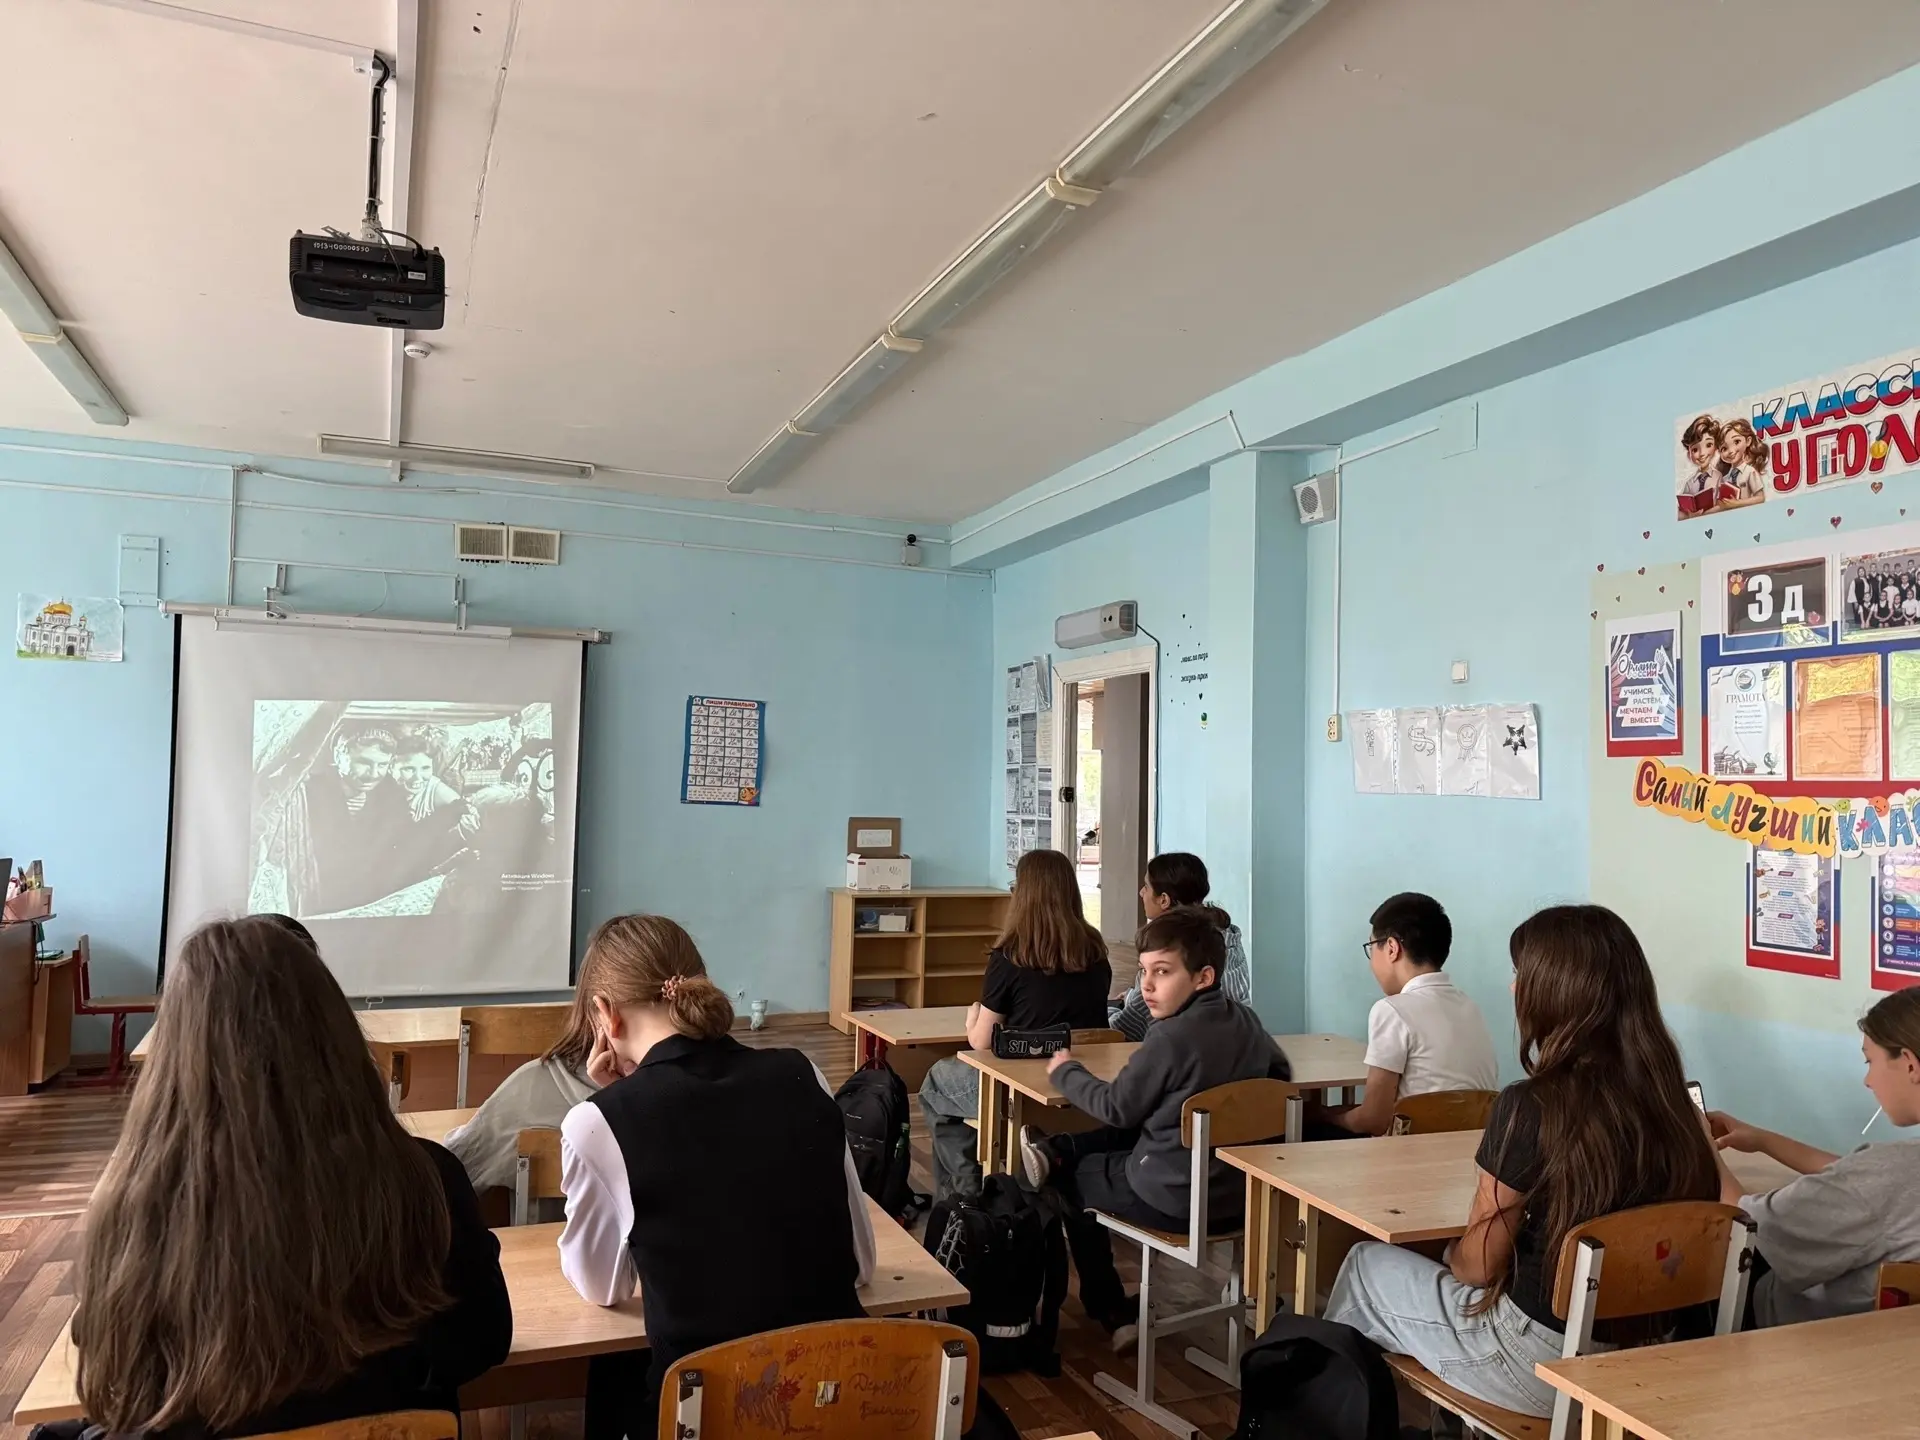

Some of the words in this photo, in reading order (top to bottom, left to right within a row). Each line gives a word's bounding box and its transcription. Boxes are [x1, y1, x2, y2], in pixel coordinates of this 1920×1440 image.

[1771, 408, 1920, 492] УГОЛ
[1623, 687, 1654, 696] УЧИМСЯ,
[1726, 692, 1766, 704] ГРАМОТА
[1620, 707, 1653, 715] МЕЧТАЕМ
[1630, 716, 1660, 724] ВМЕСТЕ!
[1636, 760, 1711, 813] Самый
[1711, 791, 1833, 847] лучший
